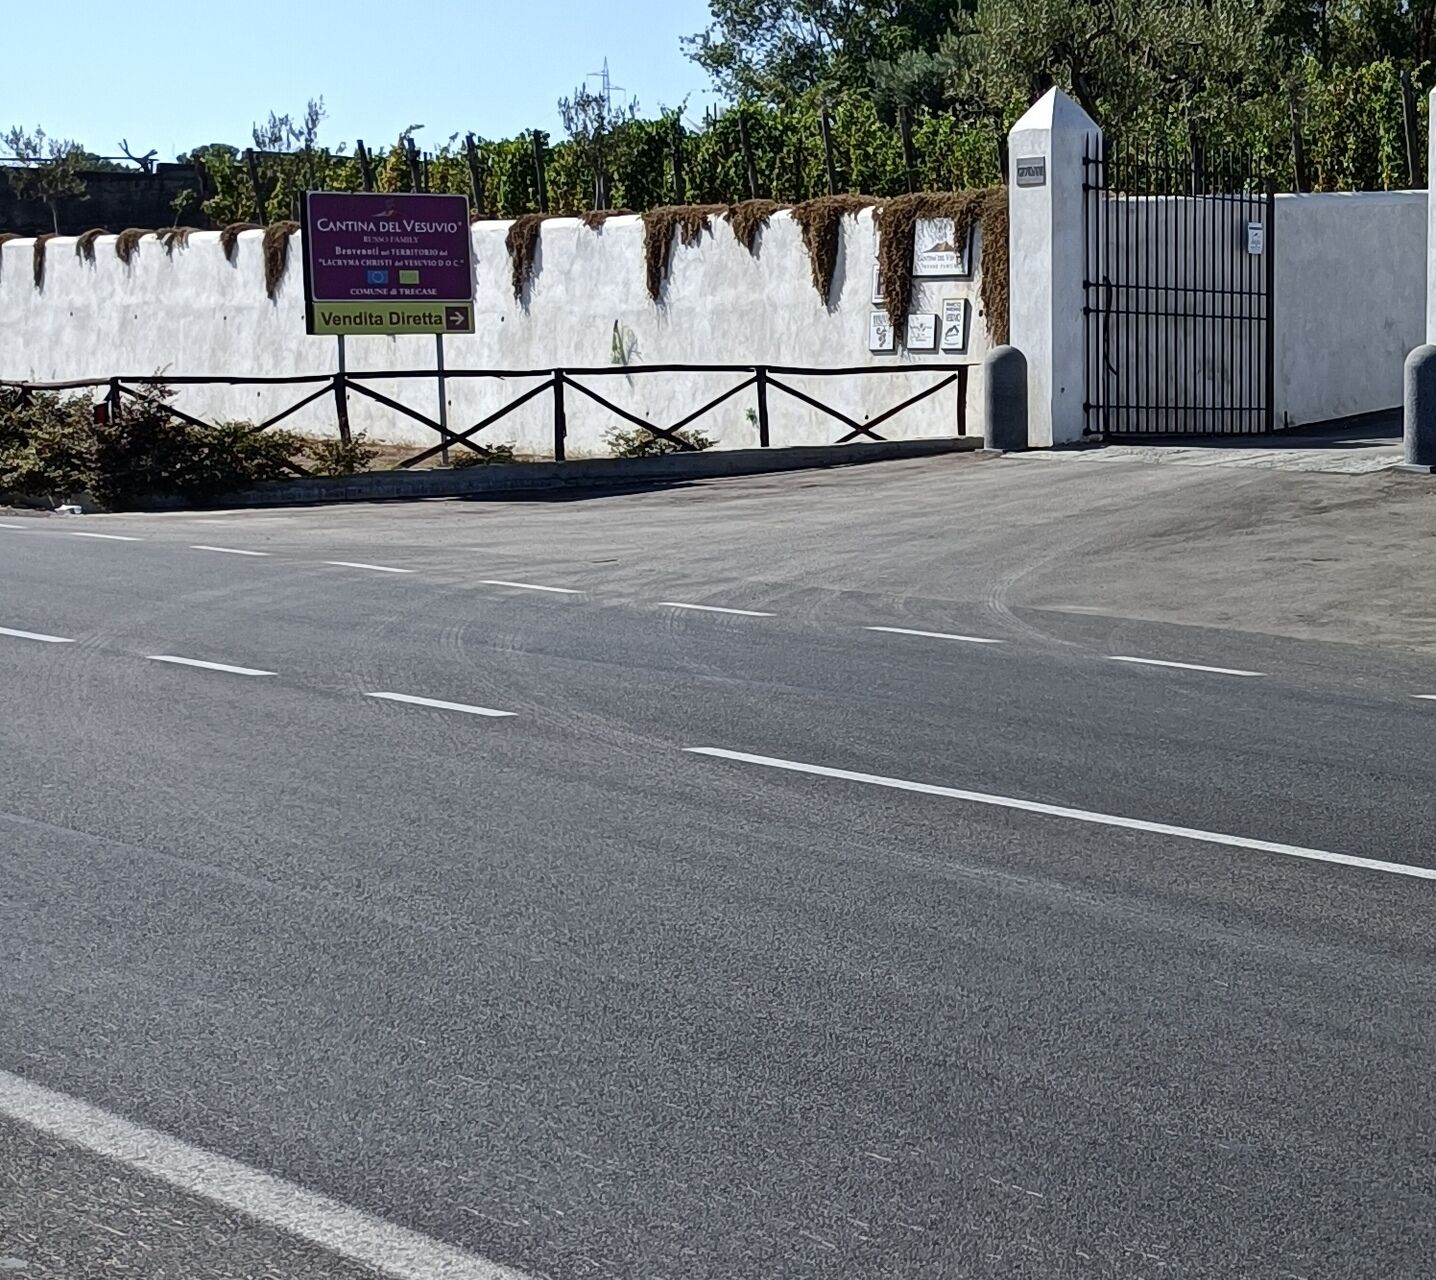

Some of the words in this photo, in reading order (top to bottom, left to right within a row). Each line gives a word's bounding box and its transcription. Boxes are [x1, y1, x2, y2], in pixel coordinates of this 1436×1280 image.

[317, 218, 376, 232] CANTINA
[379, 221, 402, 232] DEL
[335, 246, 379, 256] Benvenuti
[350, 288, 388, 296] COMUNE
[399, 288, 438, 296] TRECASE
[321, 312, 384, 326] Vendita
[388, 312, 443, 326] Diretta
